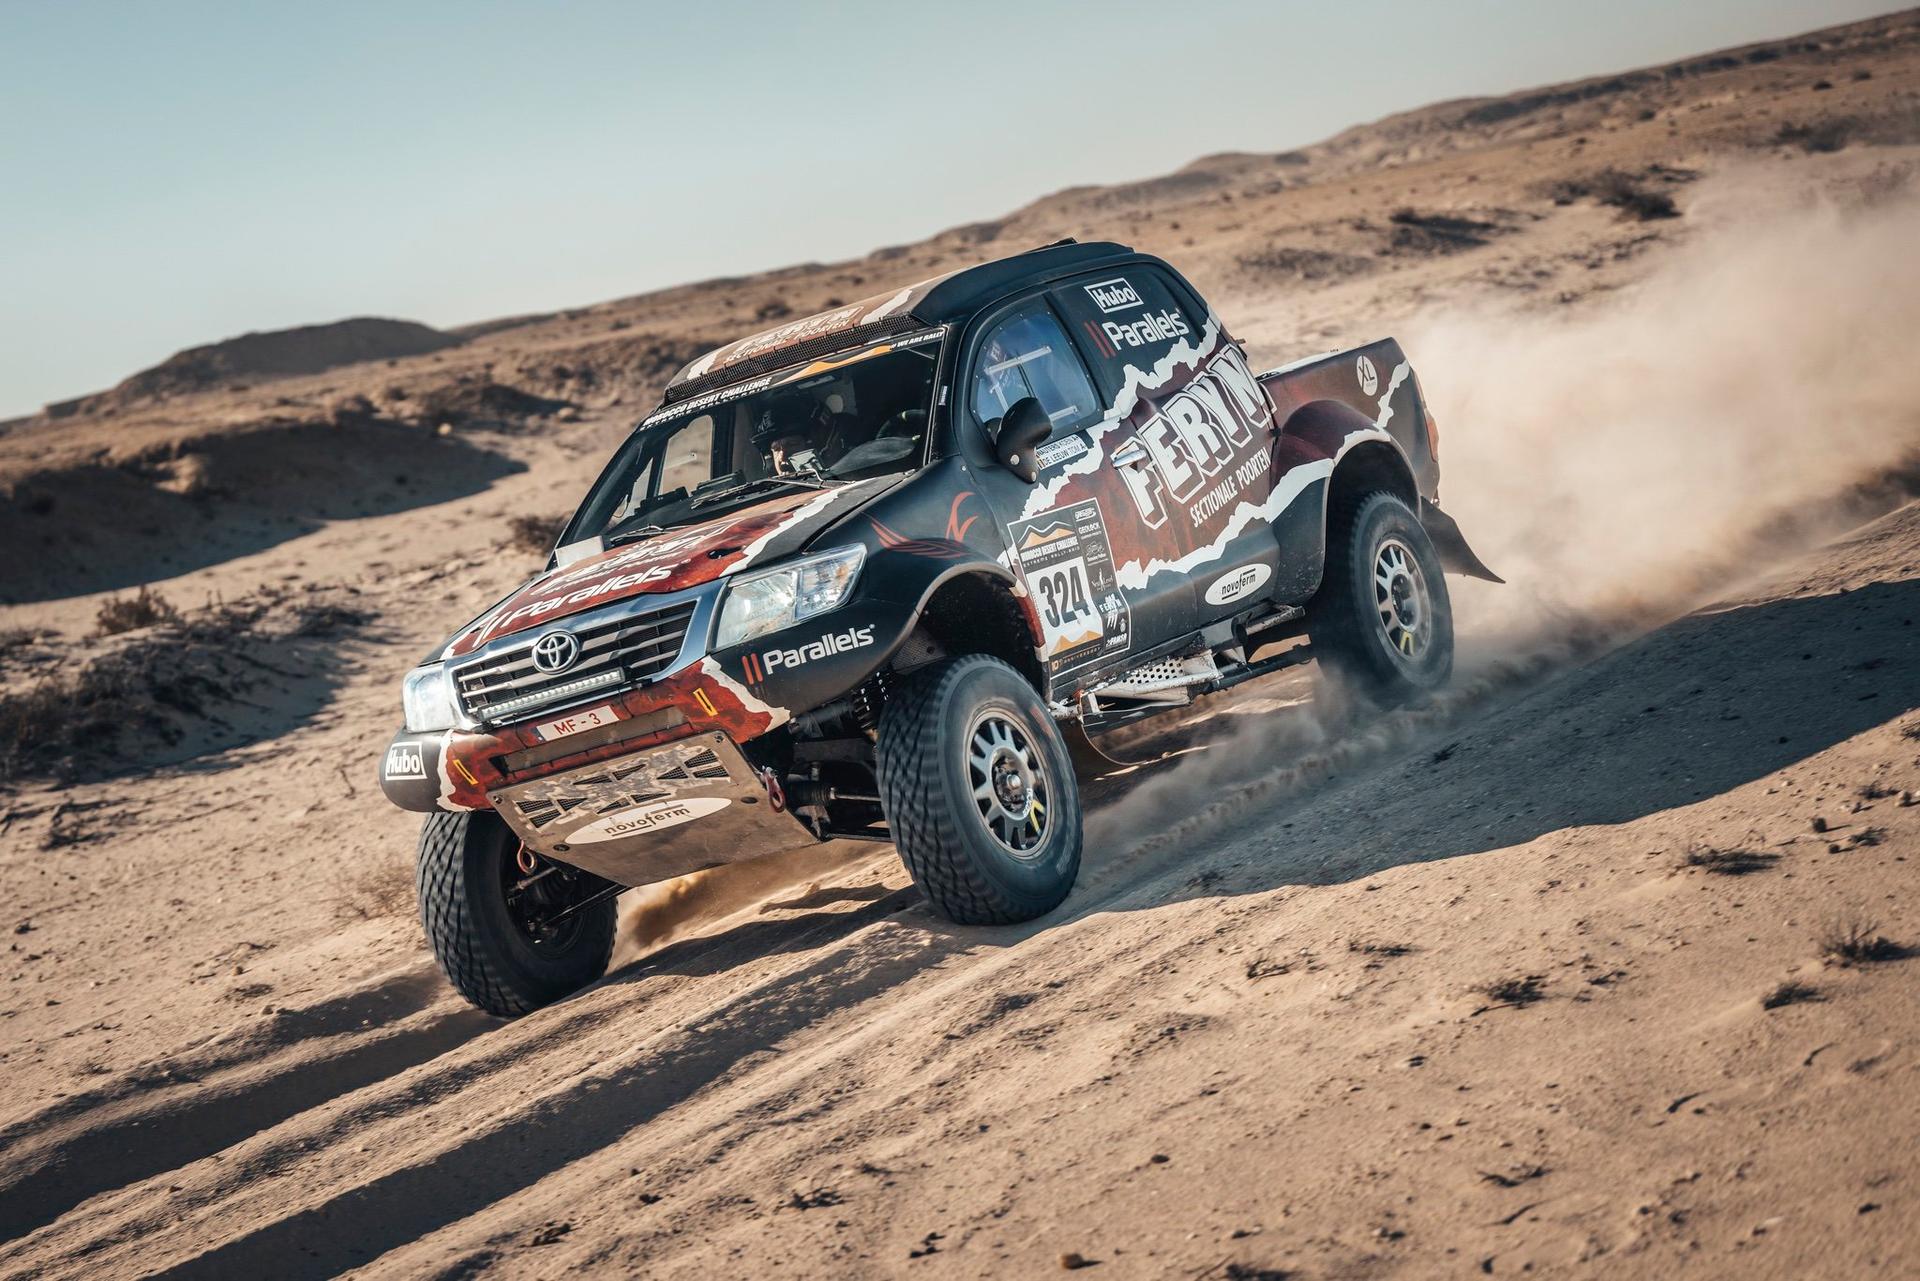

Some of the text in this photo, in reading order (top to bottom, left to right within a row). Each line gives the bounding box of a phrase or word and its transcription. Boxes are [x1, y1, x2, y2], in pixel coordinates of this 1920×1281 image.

[1092, 285, 1136, 308] Hubo
[1102, 309, 1189, 350] Parallels
[686, 393, 721, 411] DESERT
[720, 377, 773, 400] CHALLENGE
[1111, 343, 1275, 529] FERYN
[1190, 447, 1271, 527] SECTIONALE POORTEN
[500, 563, 680, 628] Parallels
[1039, 566, 1091, 628] 324
[1221, 571, 1256, 595] novoferm
[763, 627, 874, 675] Parallels
[387, 745, 421, 772] Hubo
[604, 806, 691, 836] novoferm
